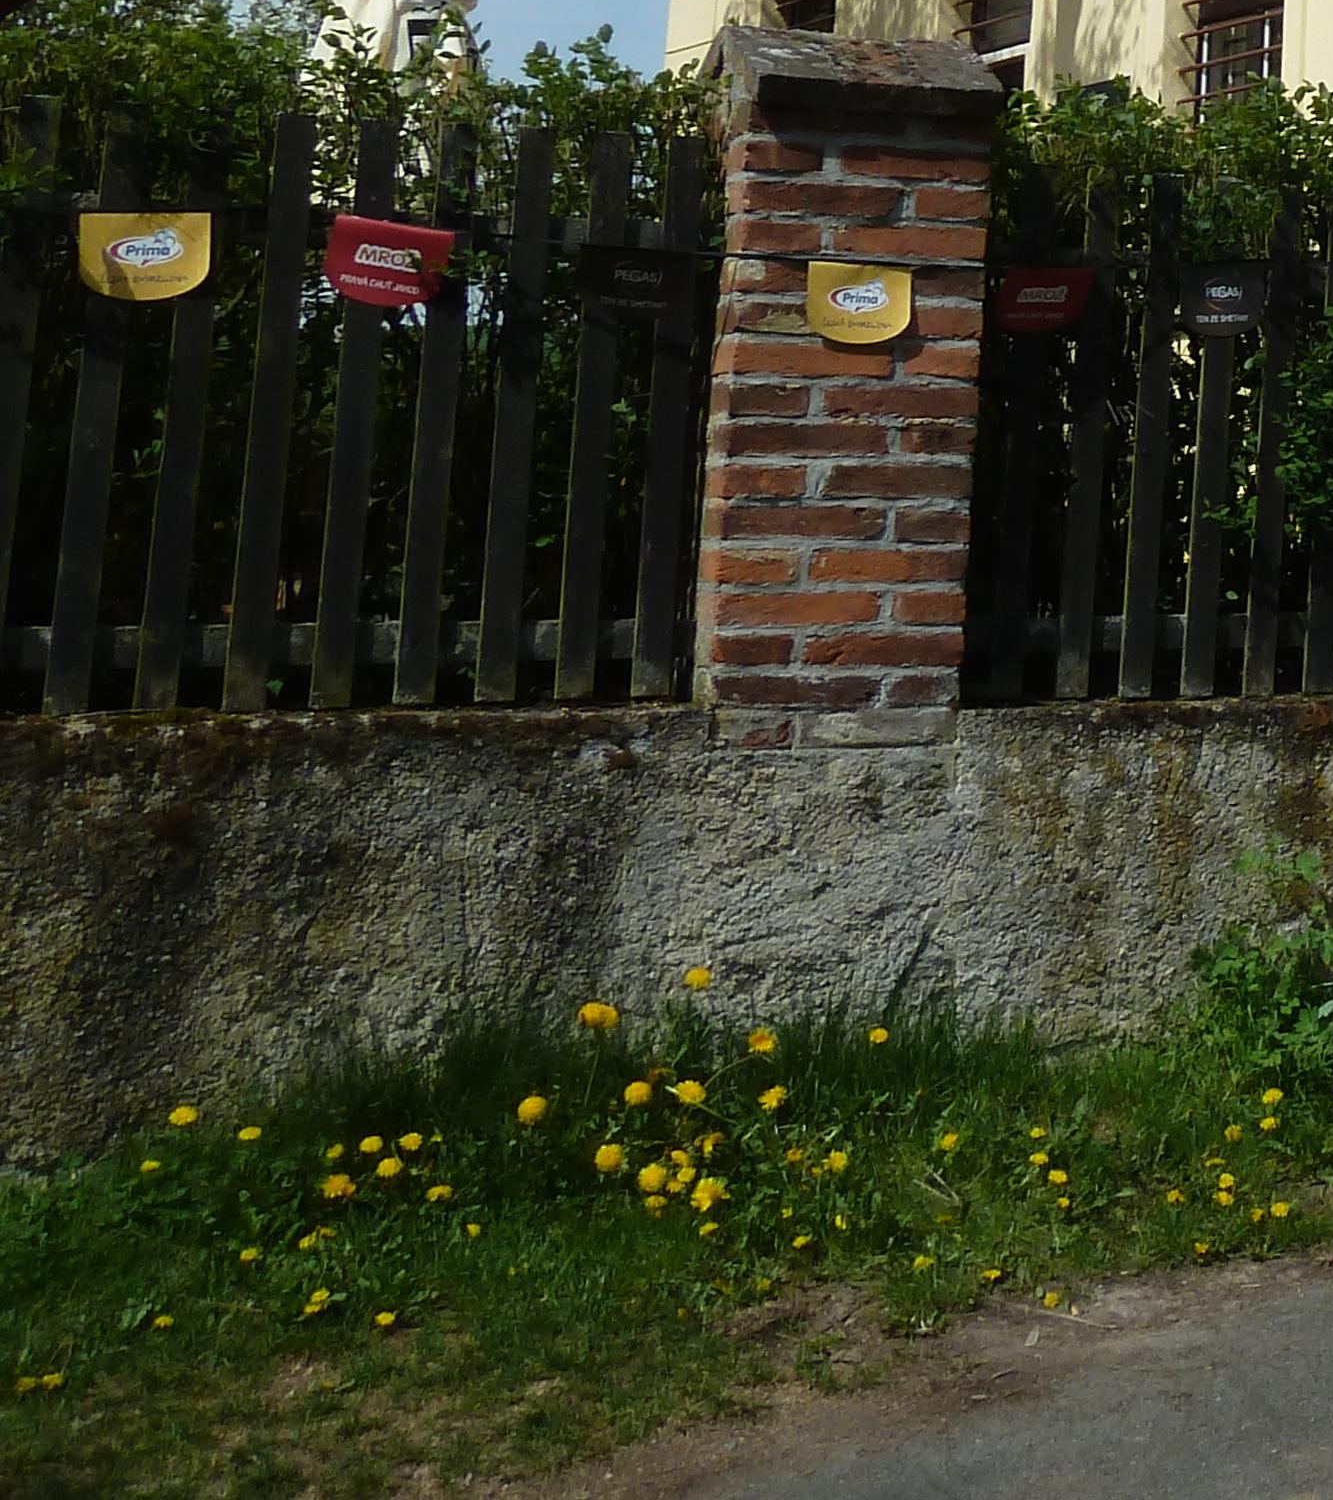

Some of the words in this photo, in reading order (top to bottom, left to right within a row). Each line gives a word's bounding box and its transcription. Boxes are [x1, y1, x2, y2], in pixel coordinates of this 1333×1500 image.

[125, 244, 171, 256] Prima
[613, 269, 658, 283] PEGAS
[842, 291, 879, 305] Prima
[1205, 285, 1239, 298] PEGAS
